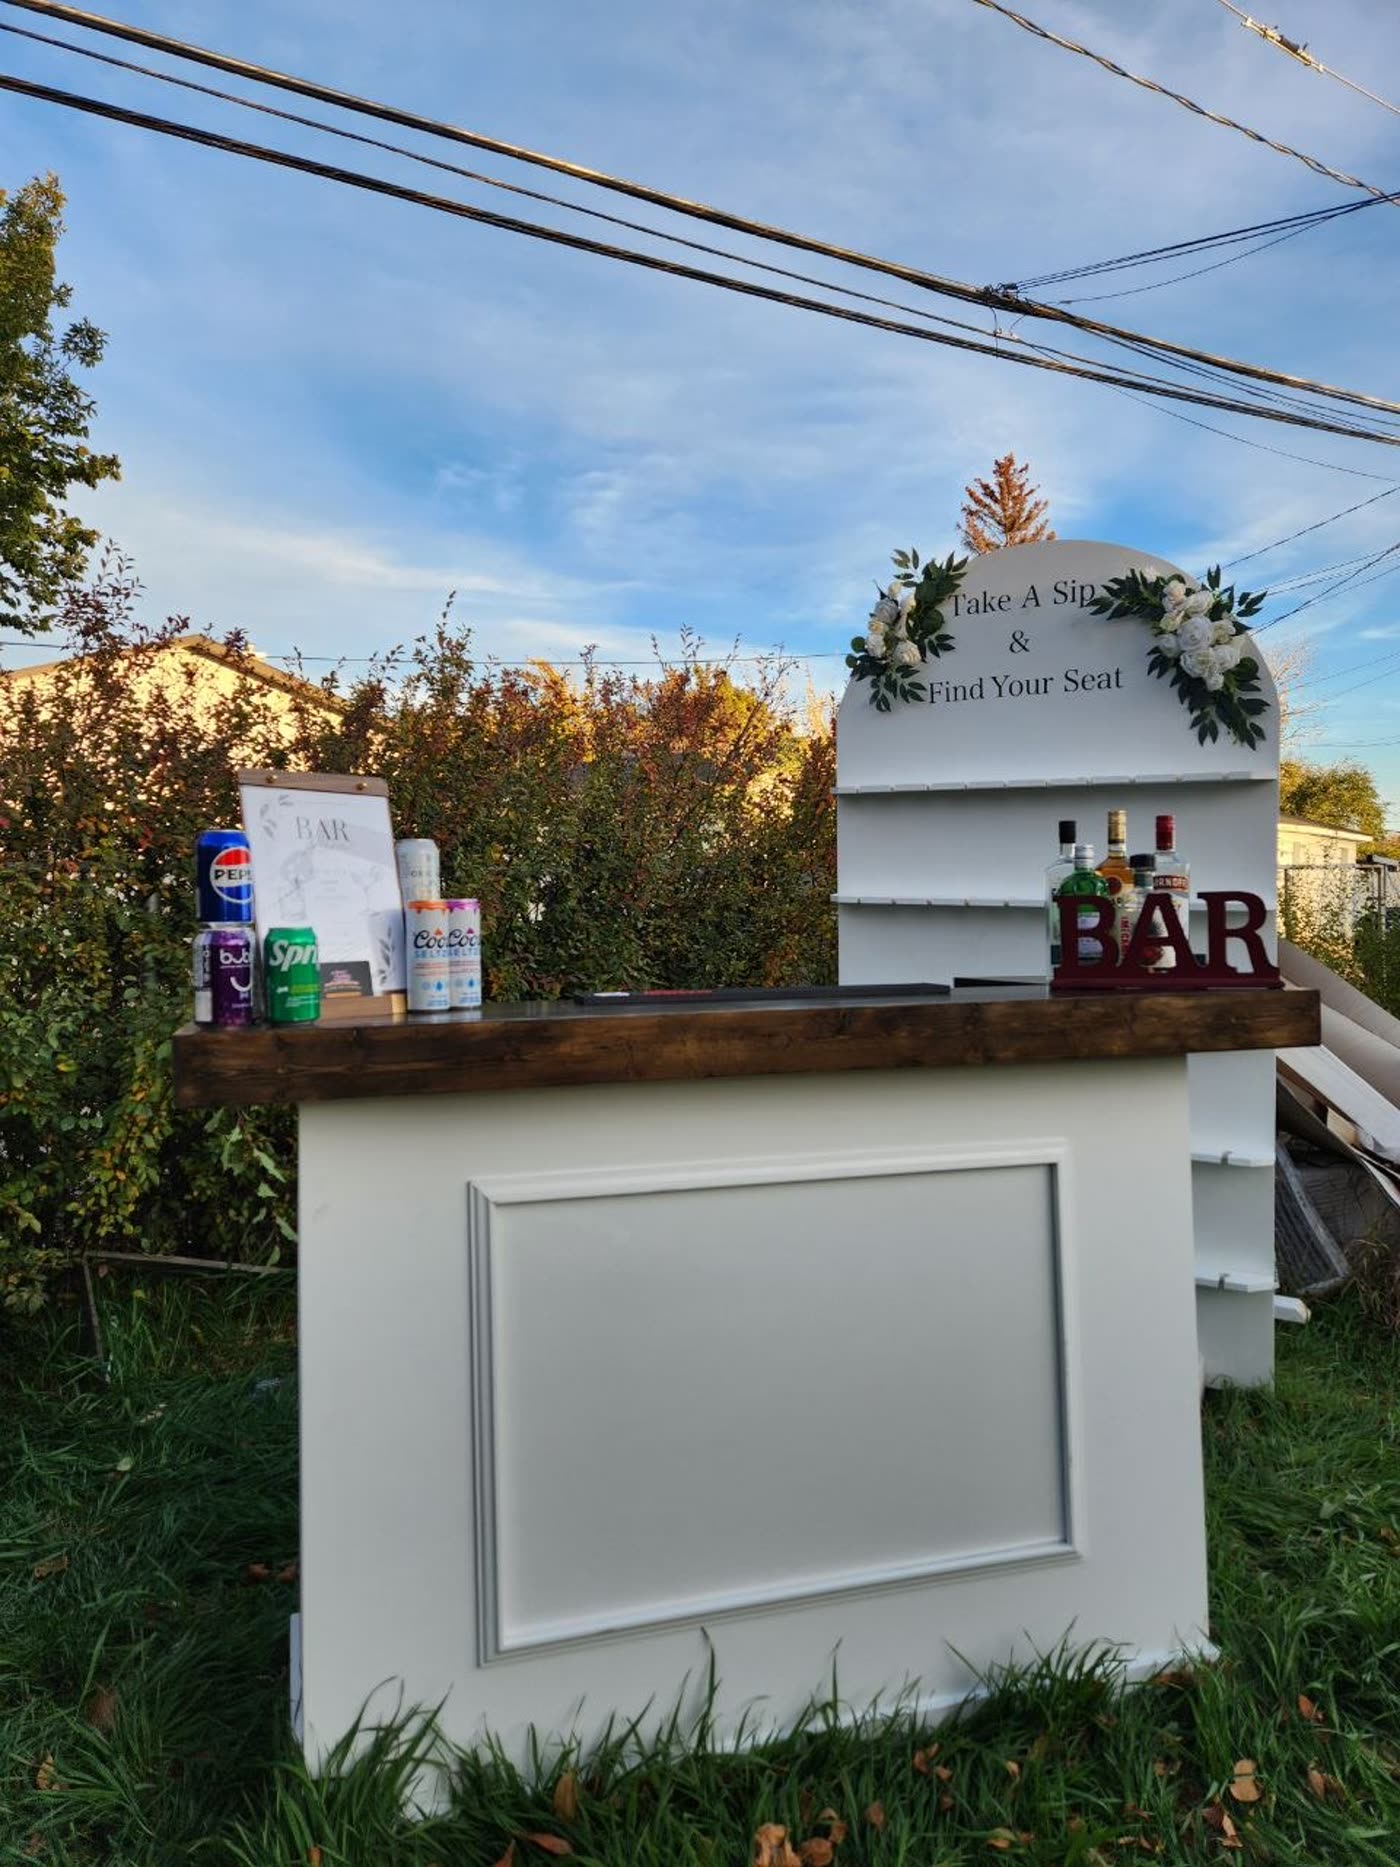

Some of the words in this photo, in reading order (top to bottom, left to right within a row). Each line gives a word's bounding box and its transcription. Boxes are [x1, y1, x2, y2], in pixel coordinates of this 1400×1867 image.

[950, 590, 1012, 617] Take
[1021, 584, 1041, 609] A
[1053, 578, 1096, 609] Sip
[1009, 629, 1031, 654] &
[929, 676, 985, 704] Find
[991, 675, 1054, 698] Your
[1063, 665, 1123, 693] Seat
[295, 815, 350, 842] BAR
[1052, 890, 1281, 973] BAR
